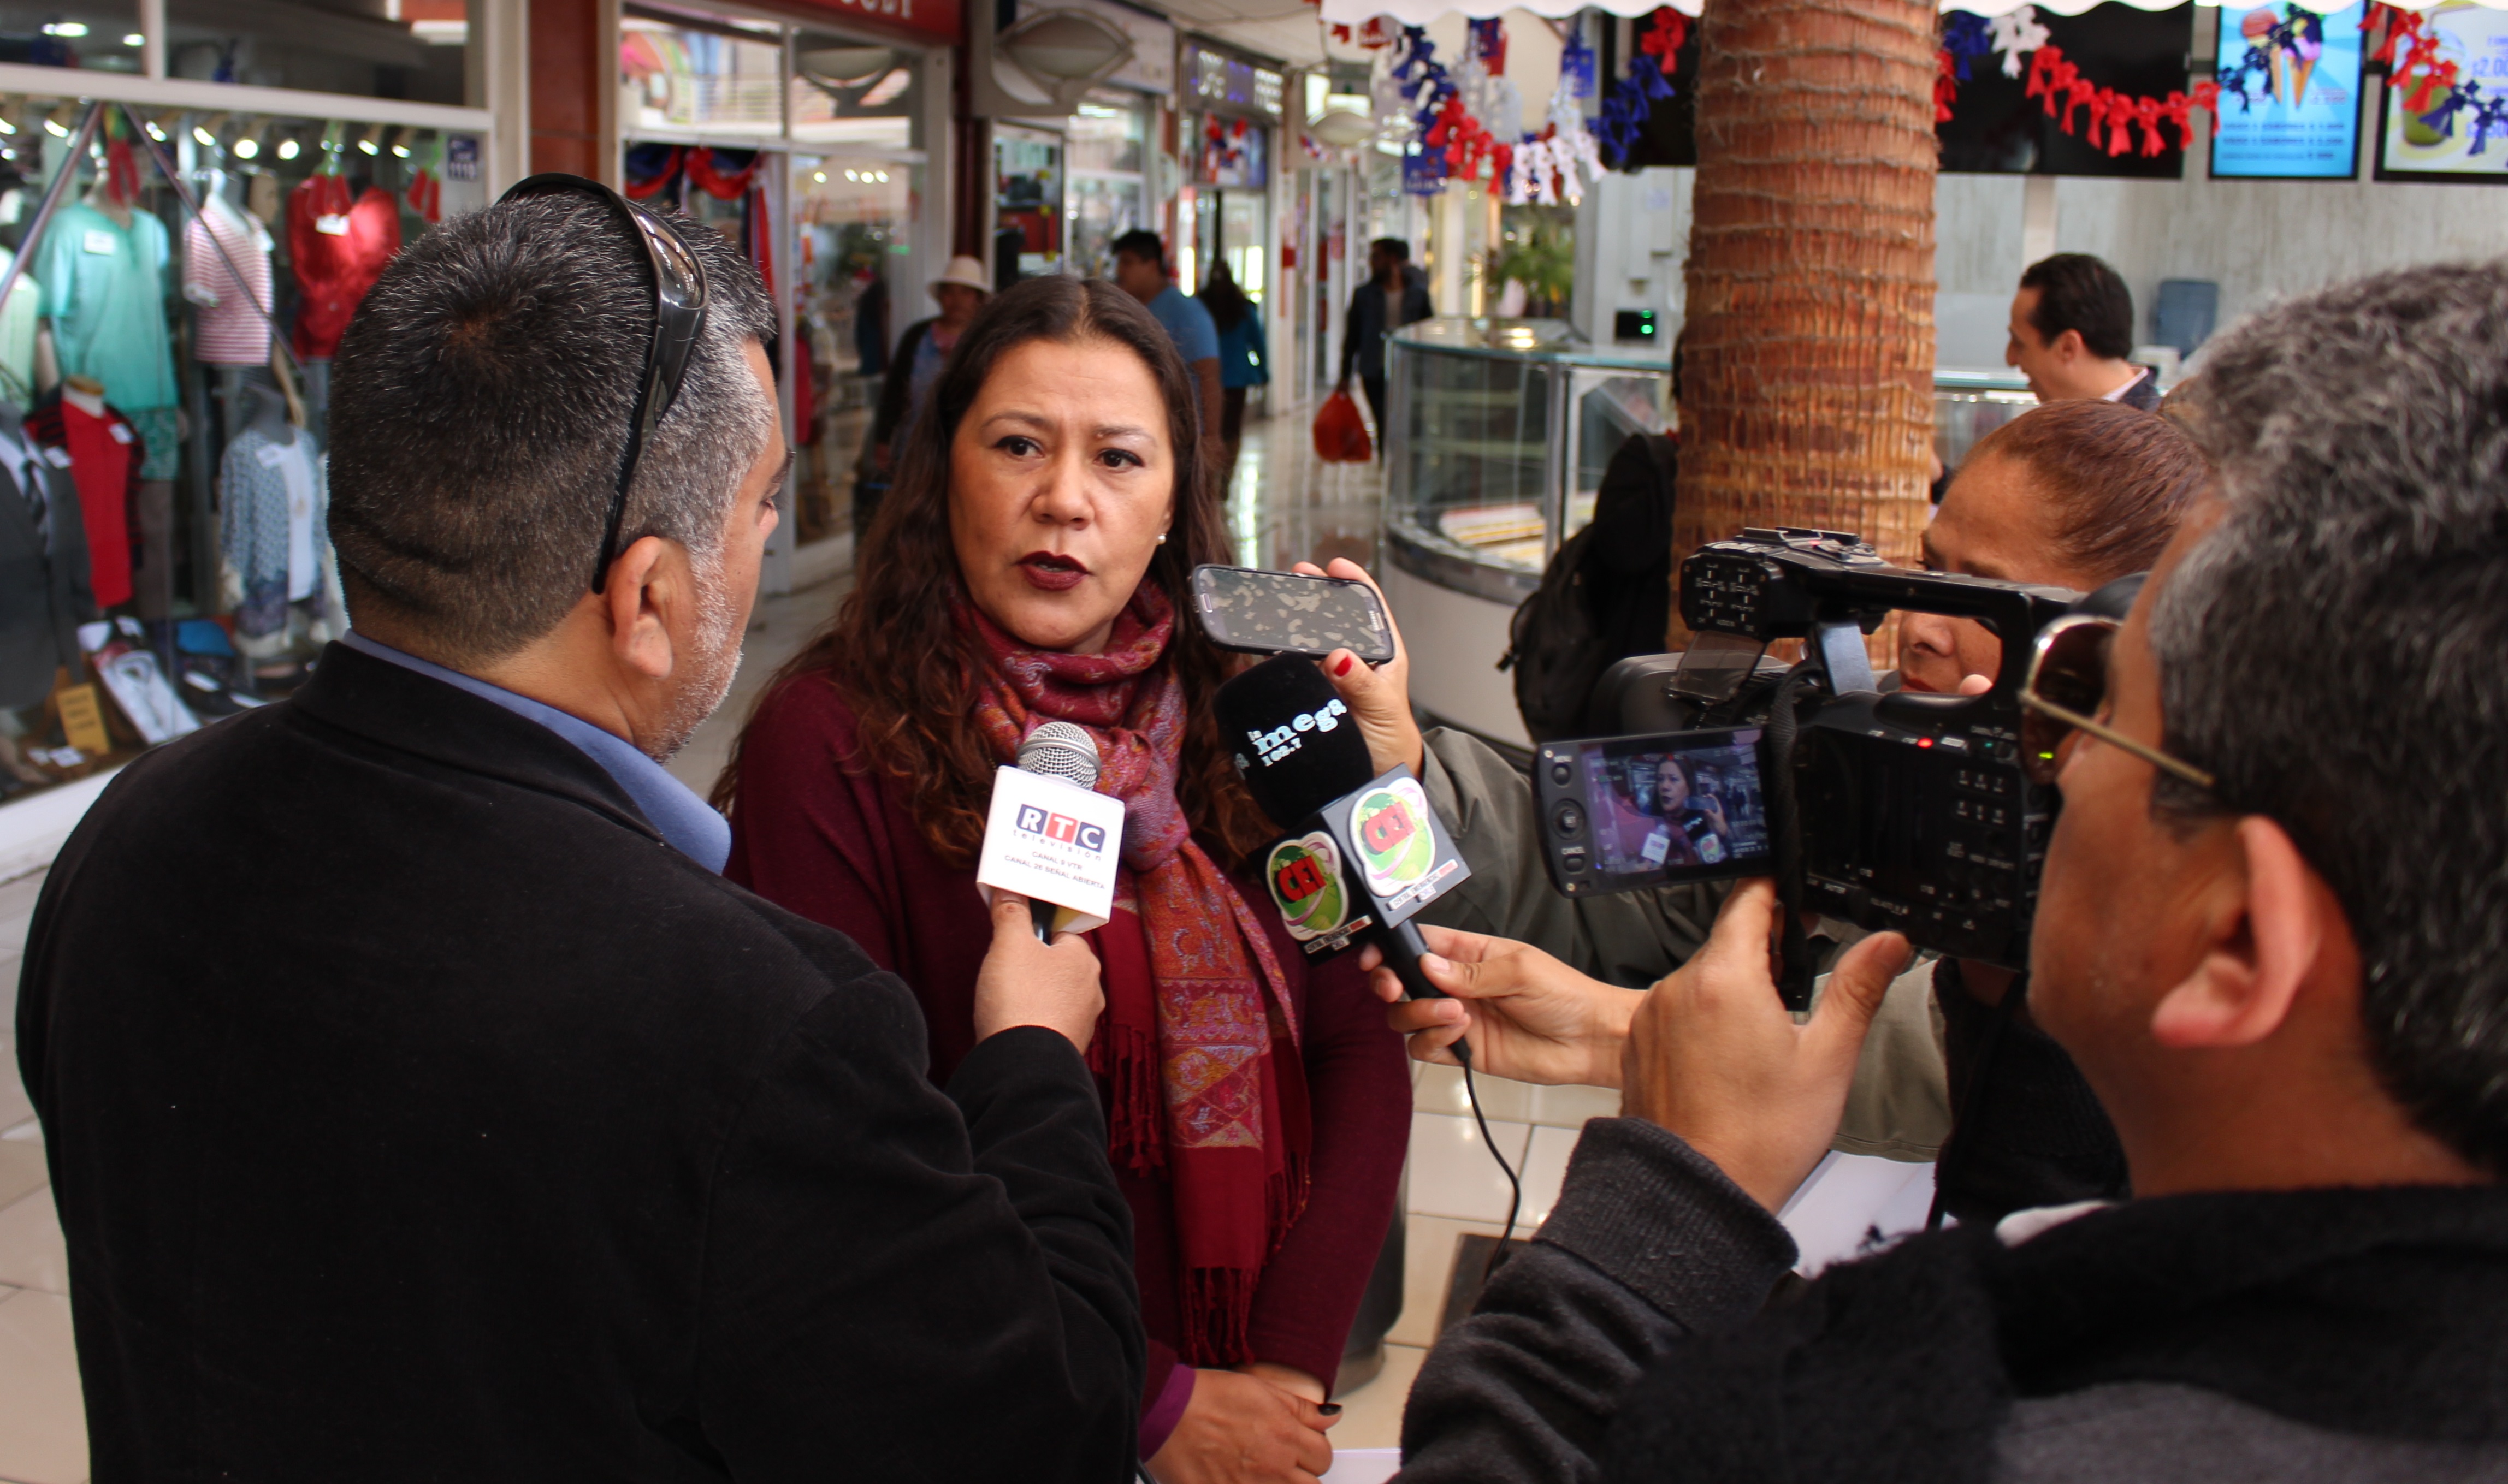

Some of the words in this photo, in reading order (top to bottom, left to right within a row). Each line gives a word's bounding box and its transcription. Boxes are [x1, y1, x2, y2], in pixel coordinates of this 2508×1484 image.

[1252, 699, 1347, 755] mega
[1261, 737, 1302, 766] 102.7
[1018, 805, 1103, 852] RTC
[1013, 829, 1101, 862] televisión
[1032, 851, 1058, 864] CANAL
[1067, 861, 1083, 870] VTR
[1004, 855, 1032, 868] CANAL
[1045, 866, 1070, 879] SEÑAL
[1073, 875, 1105, 889] ABIERTA
